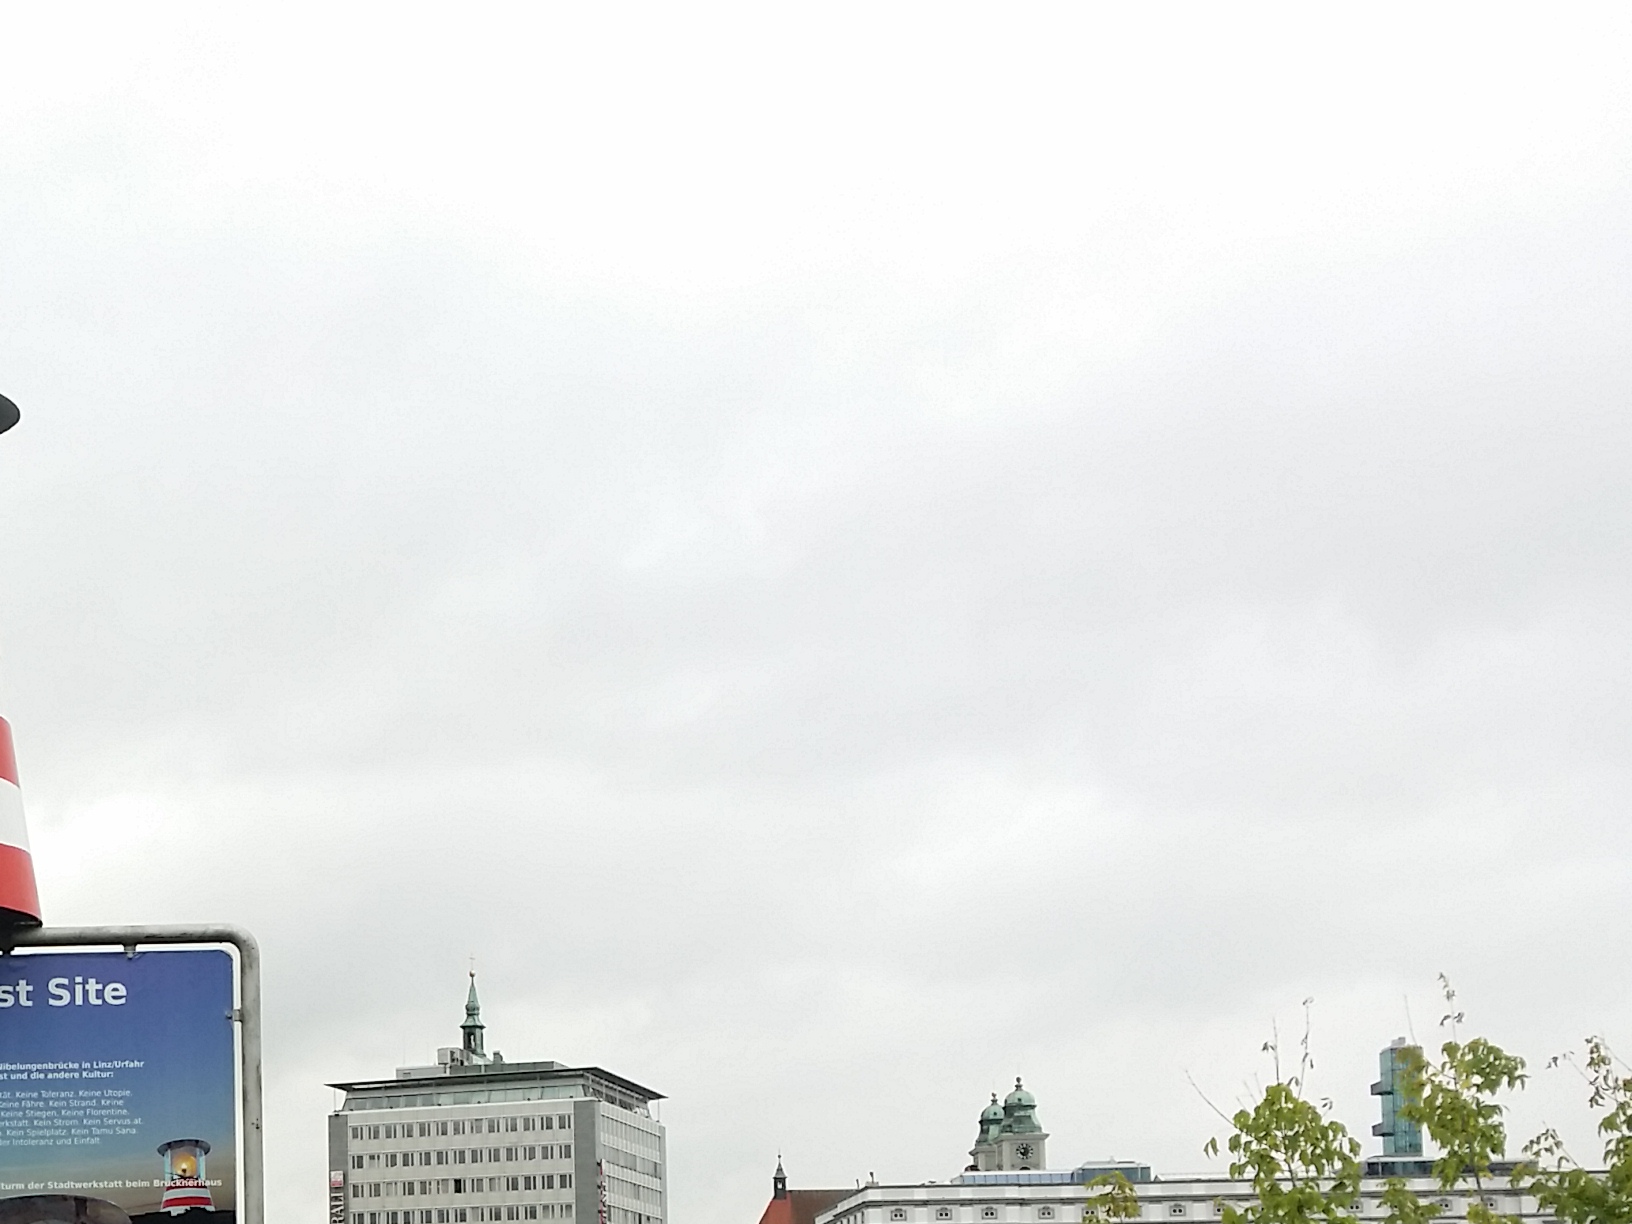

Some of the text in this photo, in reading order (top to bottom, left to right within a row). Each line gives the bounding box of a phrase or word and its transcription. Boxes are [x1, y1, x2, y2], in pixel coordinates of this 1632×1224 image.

[47, 976, 128, 1008] Site
[81, 1061, 91, 1069] in
[93, 1060, 145, 1069] Linz/Urfahr
[10, 1071, 28, 1080] und
[30, 1071, 45, 1080] die
[47, 1071, 80, 1079] andere
[15, 1091, 39, 1099] Keine
[78, 1089, 102, 1097] Keine
[6, 1128, 24, 1136] Kein
[71, 1127, 89, 1135] Kein
[91, 1127, 113, 1135] Tamu
[12, 1138, 54, 1146] Intoleranz
[27, 1181, 45, 1190] der
[47, 1180, 123, 1189] Stadtwerkstatt
[125, 1179, 150, 1188] beim
